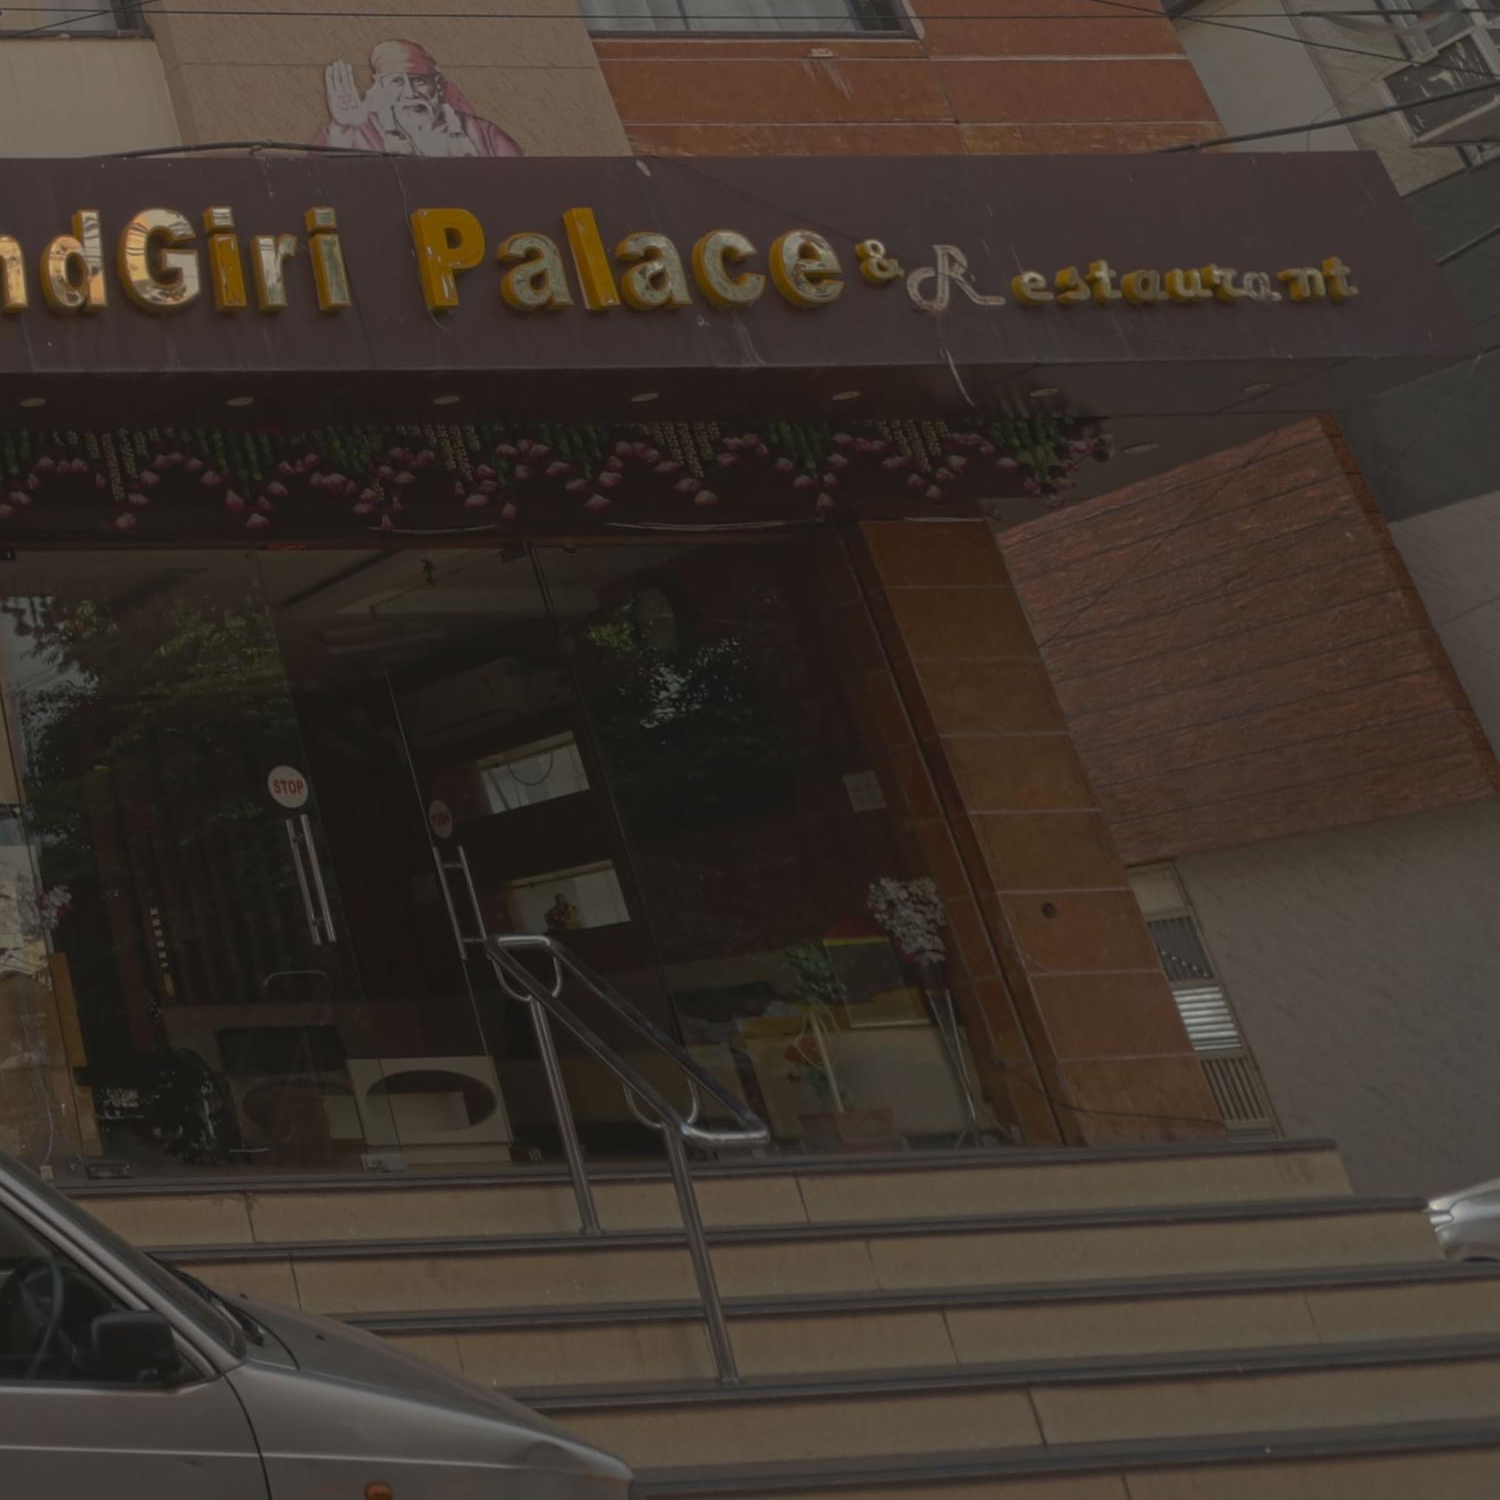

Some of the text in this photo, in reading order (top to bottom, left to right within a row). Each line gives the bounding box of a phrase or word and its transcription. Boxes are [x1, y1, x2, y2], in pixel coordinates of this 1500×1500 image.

[411, 207, 846, 311] Palace
[855, 238, 905, 284] &
[905, 243, 1360, 316] Restaurant
[272, 778, 305, 797] STOP
